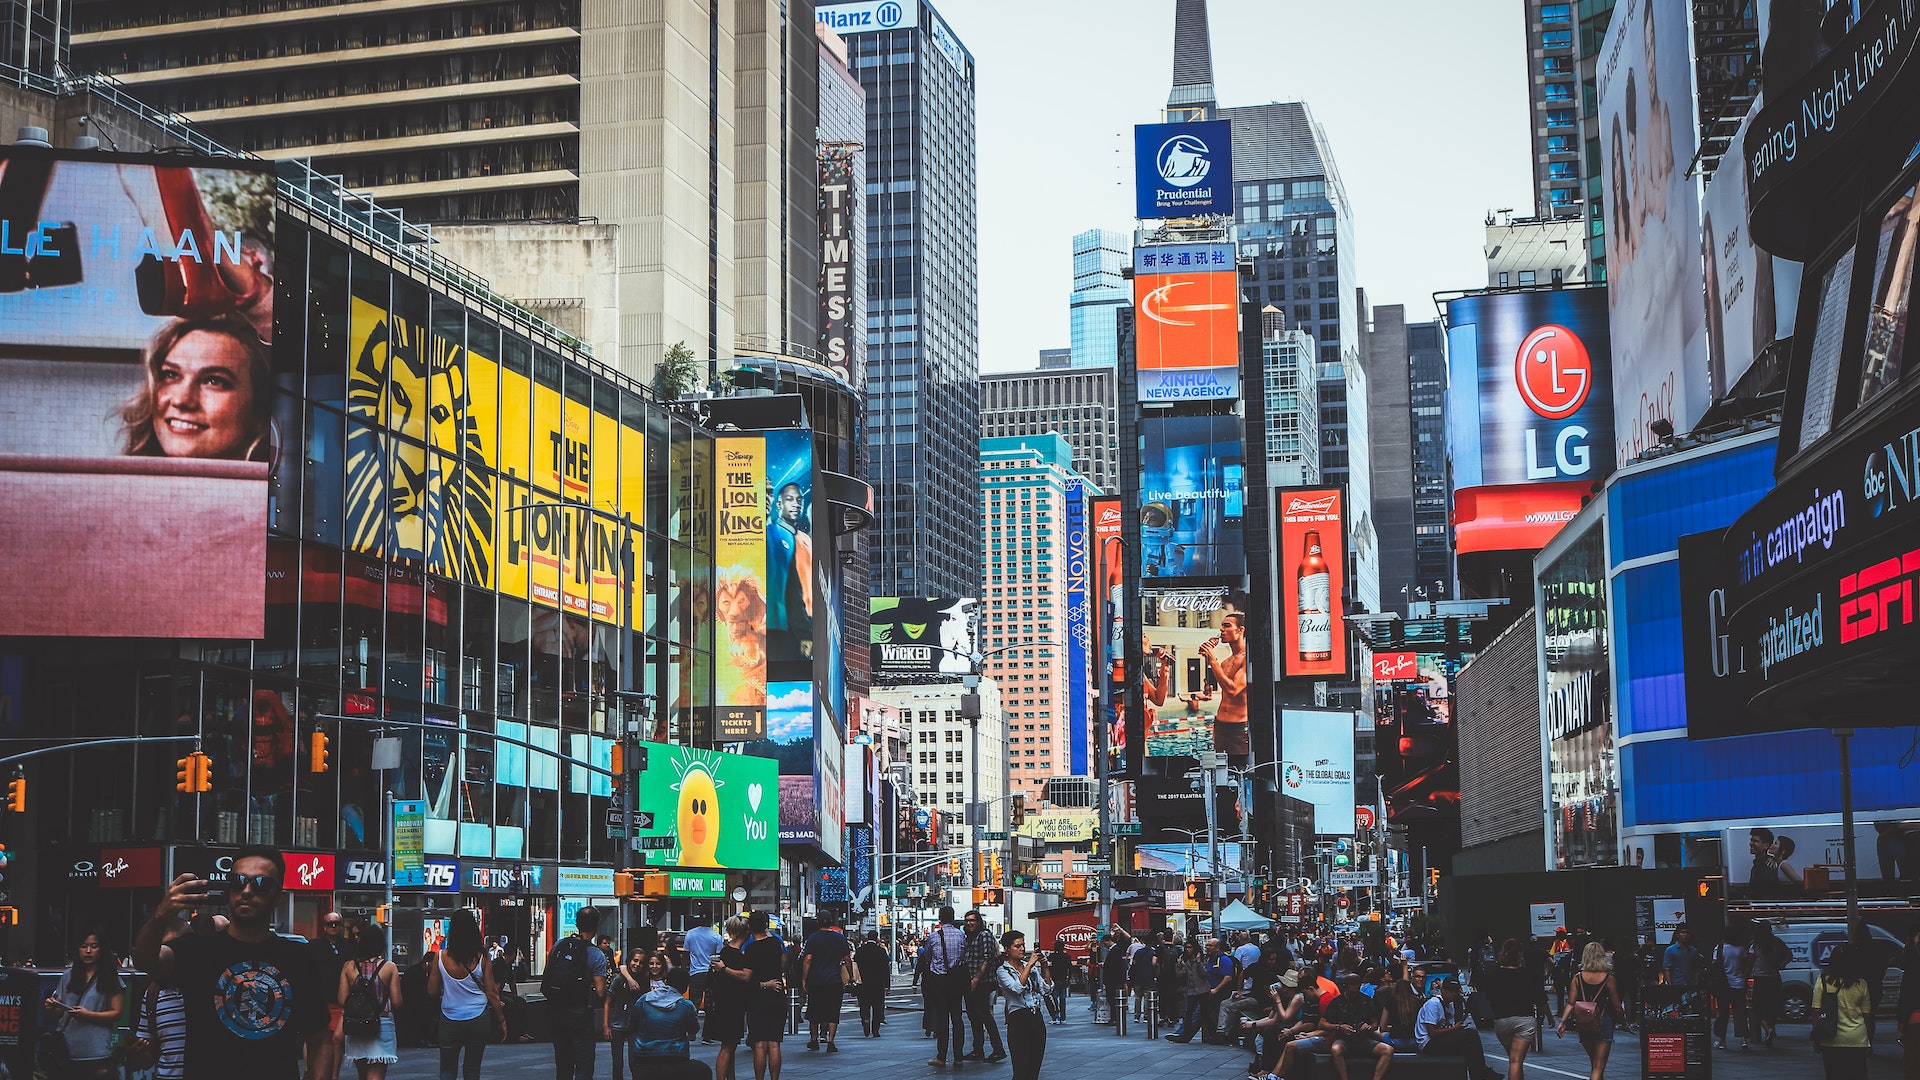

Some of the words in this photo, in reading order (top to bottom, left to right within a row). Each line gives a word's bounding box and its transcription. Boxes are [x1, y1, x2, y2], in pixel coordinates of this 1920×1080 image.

[1801, 68, 1852, 138] Night
[1854, 38, 1884, 92] Live
[1885, 14, 1898, 54] in
[1156, 187, 1212, 200] Prudential
[92, 224, 242, 266] HAAN
[824, 184, 849, 320] TIMES
[1143, 250, 1226, 267] 新华通讯社
[1159, 373, 1219, 388] XINHUA
[1146, 387, 1180, 398] NEWS
[1183, 386, 1232, 397] AGENCY
[550, 430, 589, 483] THE
[723, 450, 754, 462] Disney
[1526, 425, 1591, 480] LG
[727, 472, 752, 484] THE
[1864, 468, 1885, 499] abc
[722, 487, 758, 508] LION
[1148, 490, 1172, 500] Live
[1175, 488, 1230, 499] beautiful
[1292, 500, 1331, 511] Budweiser
[508, 467, 571, 566] LION
[720, 510, 763, 535] KING
[1284, 515, 1297, 523] THIS
[1297, 514, 1314, 523] BUD'S
[1326, 513, 1340, 521] YOU.
[1766, 488, 1846, 568] campaign
[1068, 491, 1084, 593] NOVOTEL
[534, 584, 558, 601] ENTRANCE
[564, 594, 573, 605] ON
[575, 597, 587, 609] 45TH
[592, 603, 606, 615] STREET
[1375, 654, 1414, 676] Ray-Ban
[1547, 688, 1565, 742] OLD
[1565, 669, 1593, 734] NAVY
[1305, 769, 1315, 779] THE
[1315, 770, 1334, 779] GLOBAL
[1334, 771, 1351, 780] GOALS
[744, 812, 767, 840] YOU
[1112, 825, 1120, 833] W
[1121, 824, 1132, 833] 44
[644, 838, 651, 848] W
[654, 838, 665, 848] 44
[102, 857, 130, 878] Ray-Ban
[209, 873, 227, 881] OAK
[298, 857, 325, 886] Ray-Ban
[672, 878, 687, 891] NEW
[688, 878, 704, 891] YORK
[710, 879, 724, 891] LINE
